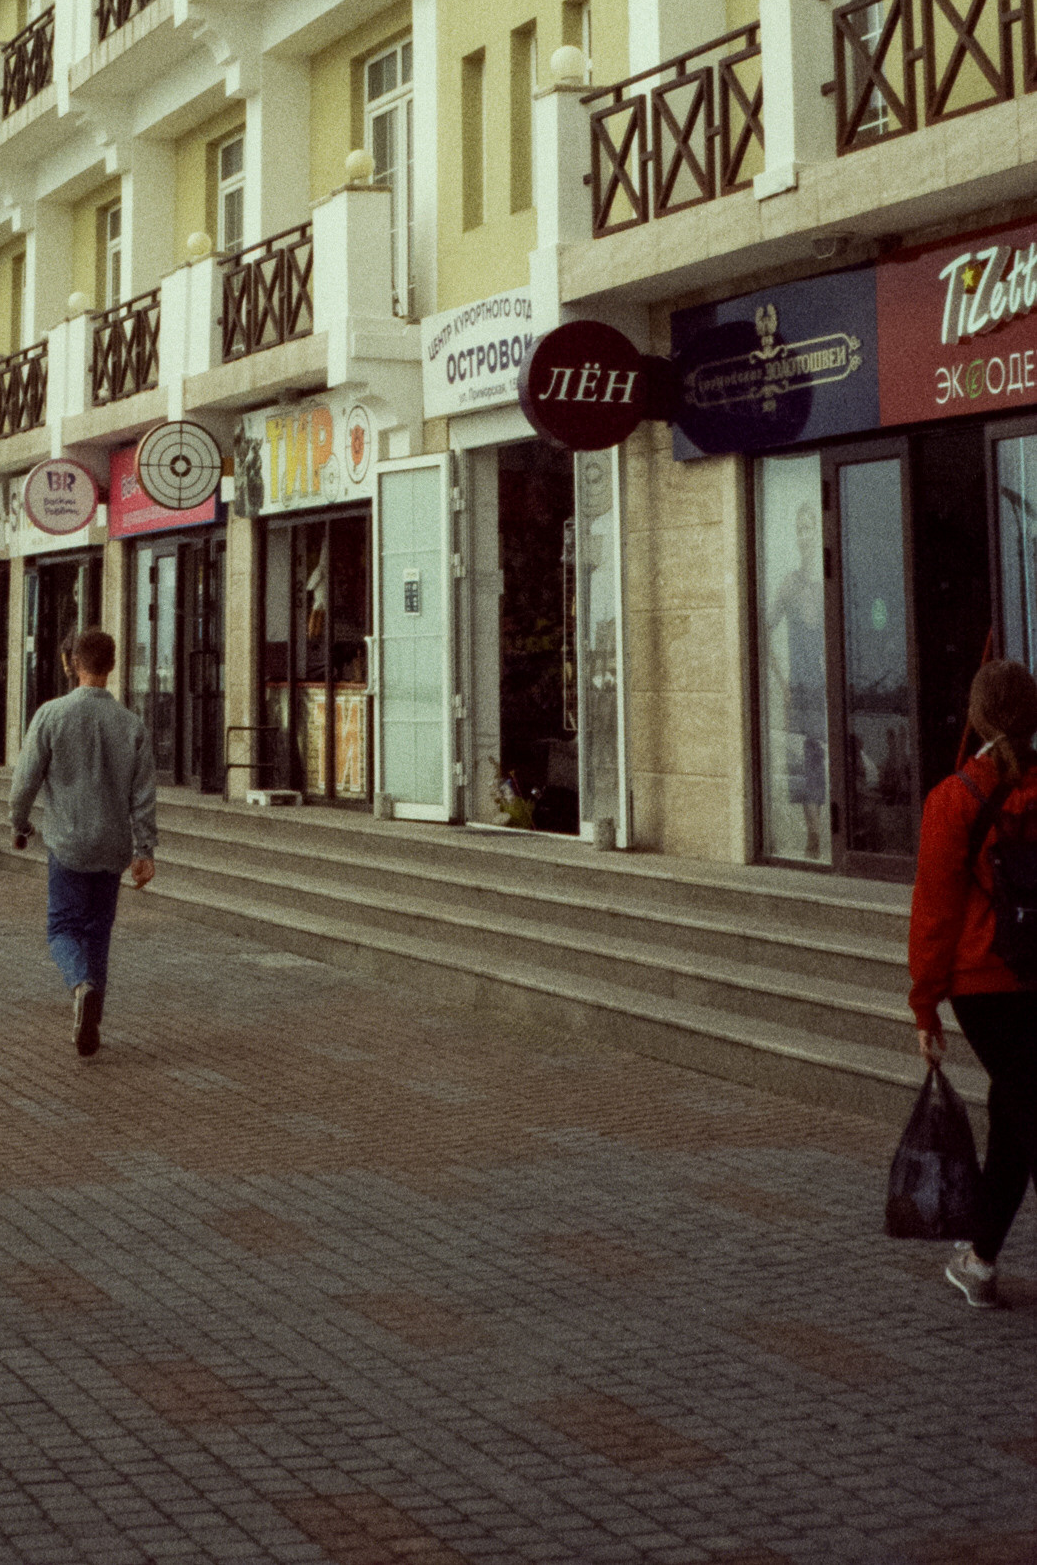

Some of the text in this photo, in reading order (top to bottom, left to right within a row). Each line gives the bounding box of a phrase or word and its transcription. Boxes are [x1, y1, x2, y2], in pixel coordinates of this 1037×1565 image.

[428, 325, 453, 361] ЦЕНТР
[454, 299, 511, 338] КУРОРТНОГО
[538, 363, 639, 404] ЛЁН
[266, 406, 333, 503] ТИР
[46, 471, 77, 492] BR
